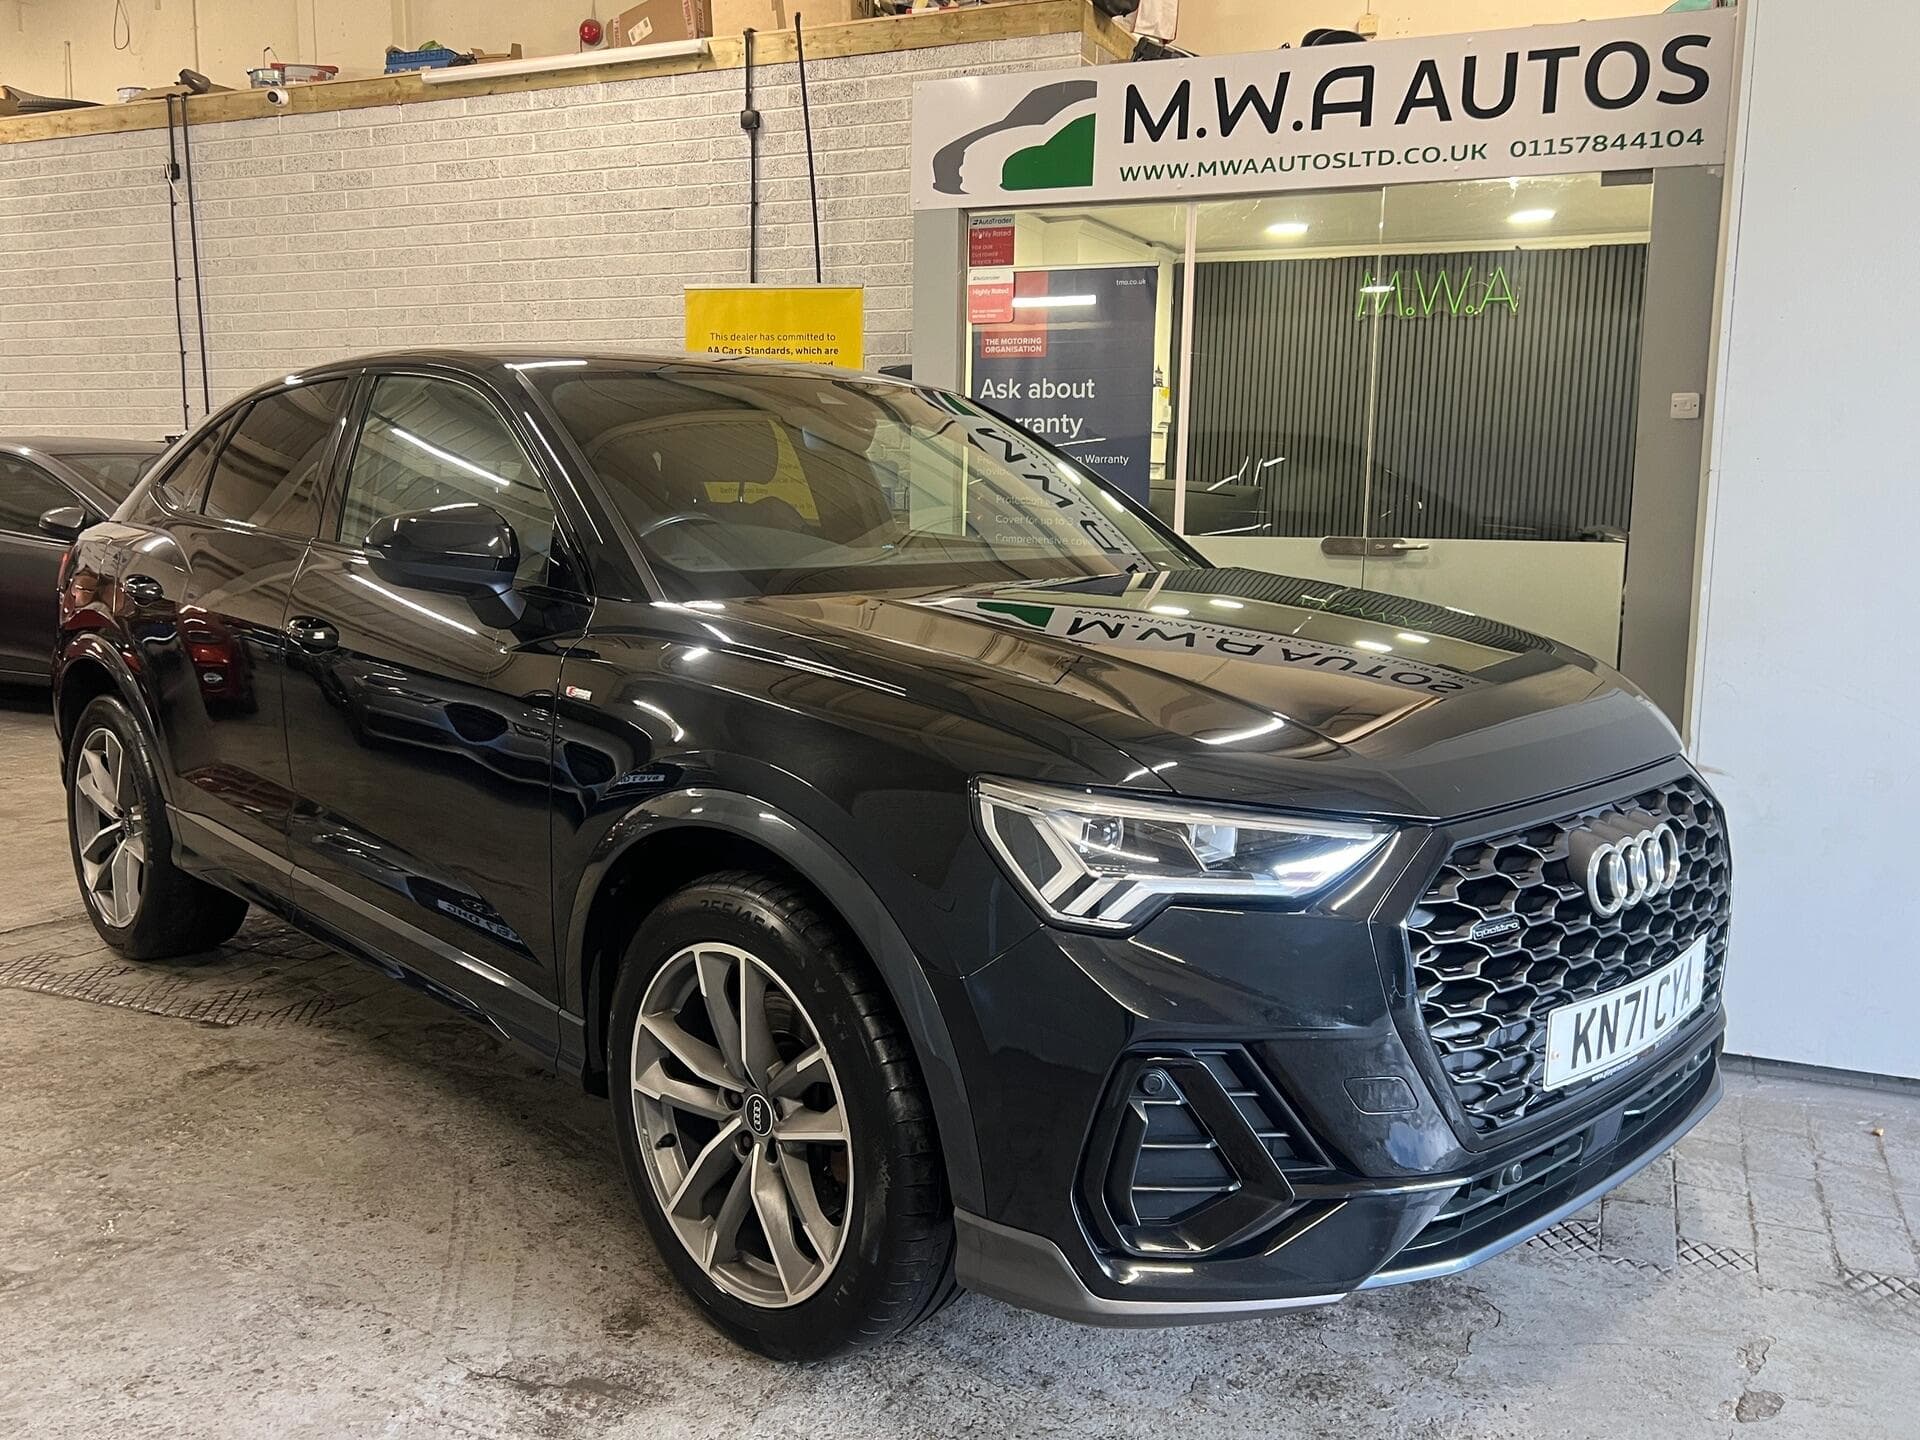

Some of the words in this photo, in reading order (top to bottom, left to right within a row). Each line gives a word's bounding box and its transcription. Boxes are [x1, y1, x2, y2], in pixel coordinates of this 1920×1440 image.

[1123, 64, 1375, 144] M.W.A
[1393, 34, 1712, 125] AUTOS
[1119, 142, 1487, 182] WWW.MWAAUTOSLTD.CO.UK
[1509, 128, 1705, 158] 01157844104
[1358, 266, 1517, 318] M.W.A
[710, 332, 728, 342] This
[730, 332, 758, 342] dealer
[759, 332, 775, 342] has
[776, 332, 825, 342] committed
[826, 333, 836, 342] to
[985, 338, 999, 346] THE
[1000, 337, 1042, 346] MOTORING
[721, 346, 743, 355] Cars
[744, 346, 794, 356] Standards,
[795, 346, 822, 355] which
[985, 345, 1042, 354] ORGANISATION
[979, 378, 1022, 400] Ask
[1028, 377, 1096, 400] about
[1084, 454, 1130, 466] Warranty
[1475, 921, 1519, 939] quattro
